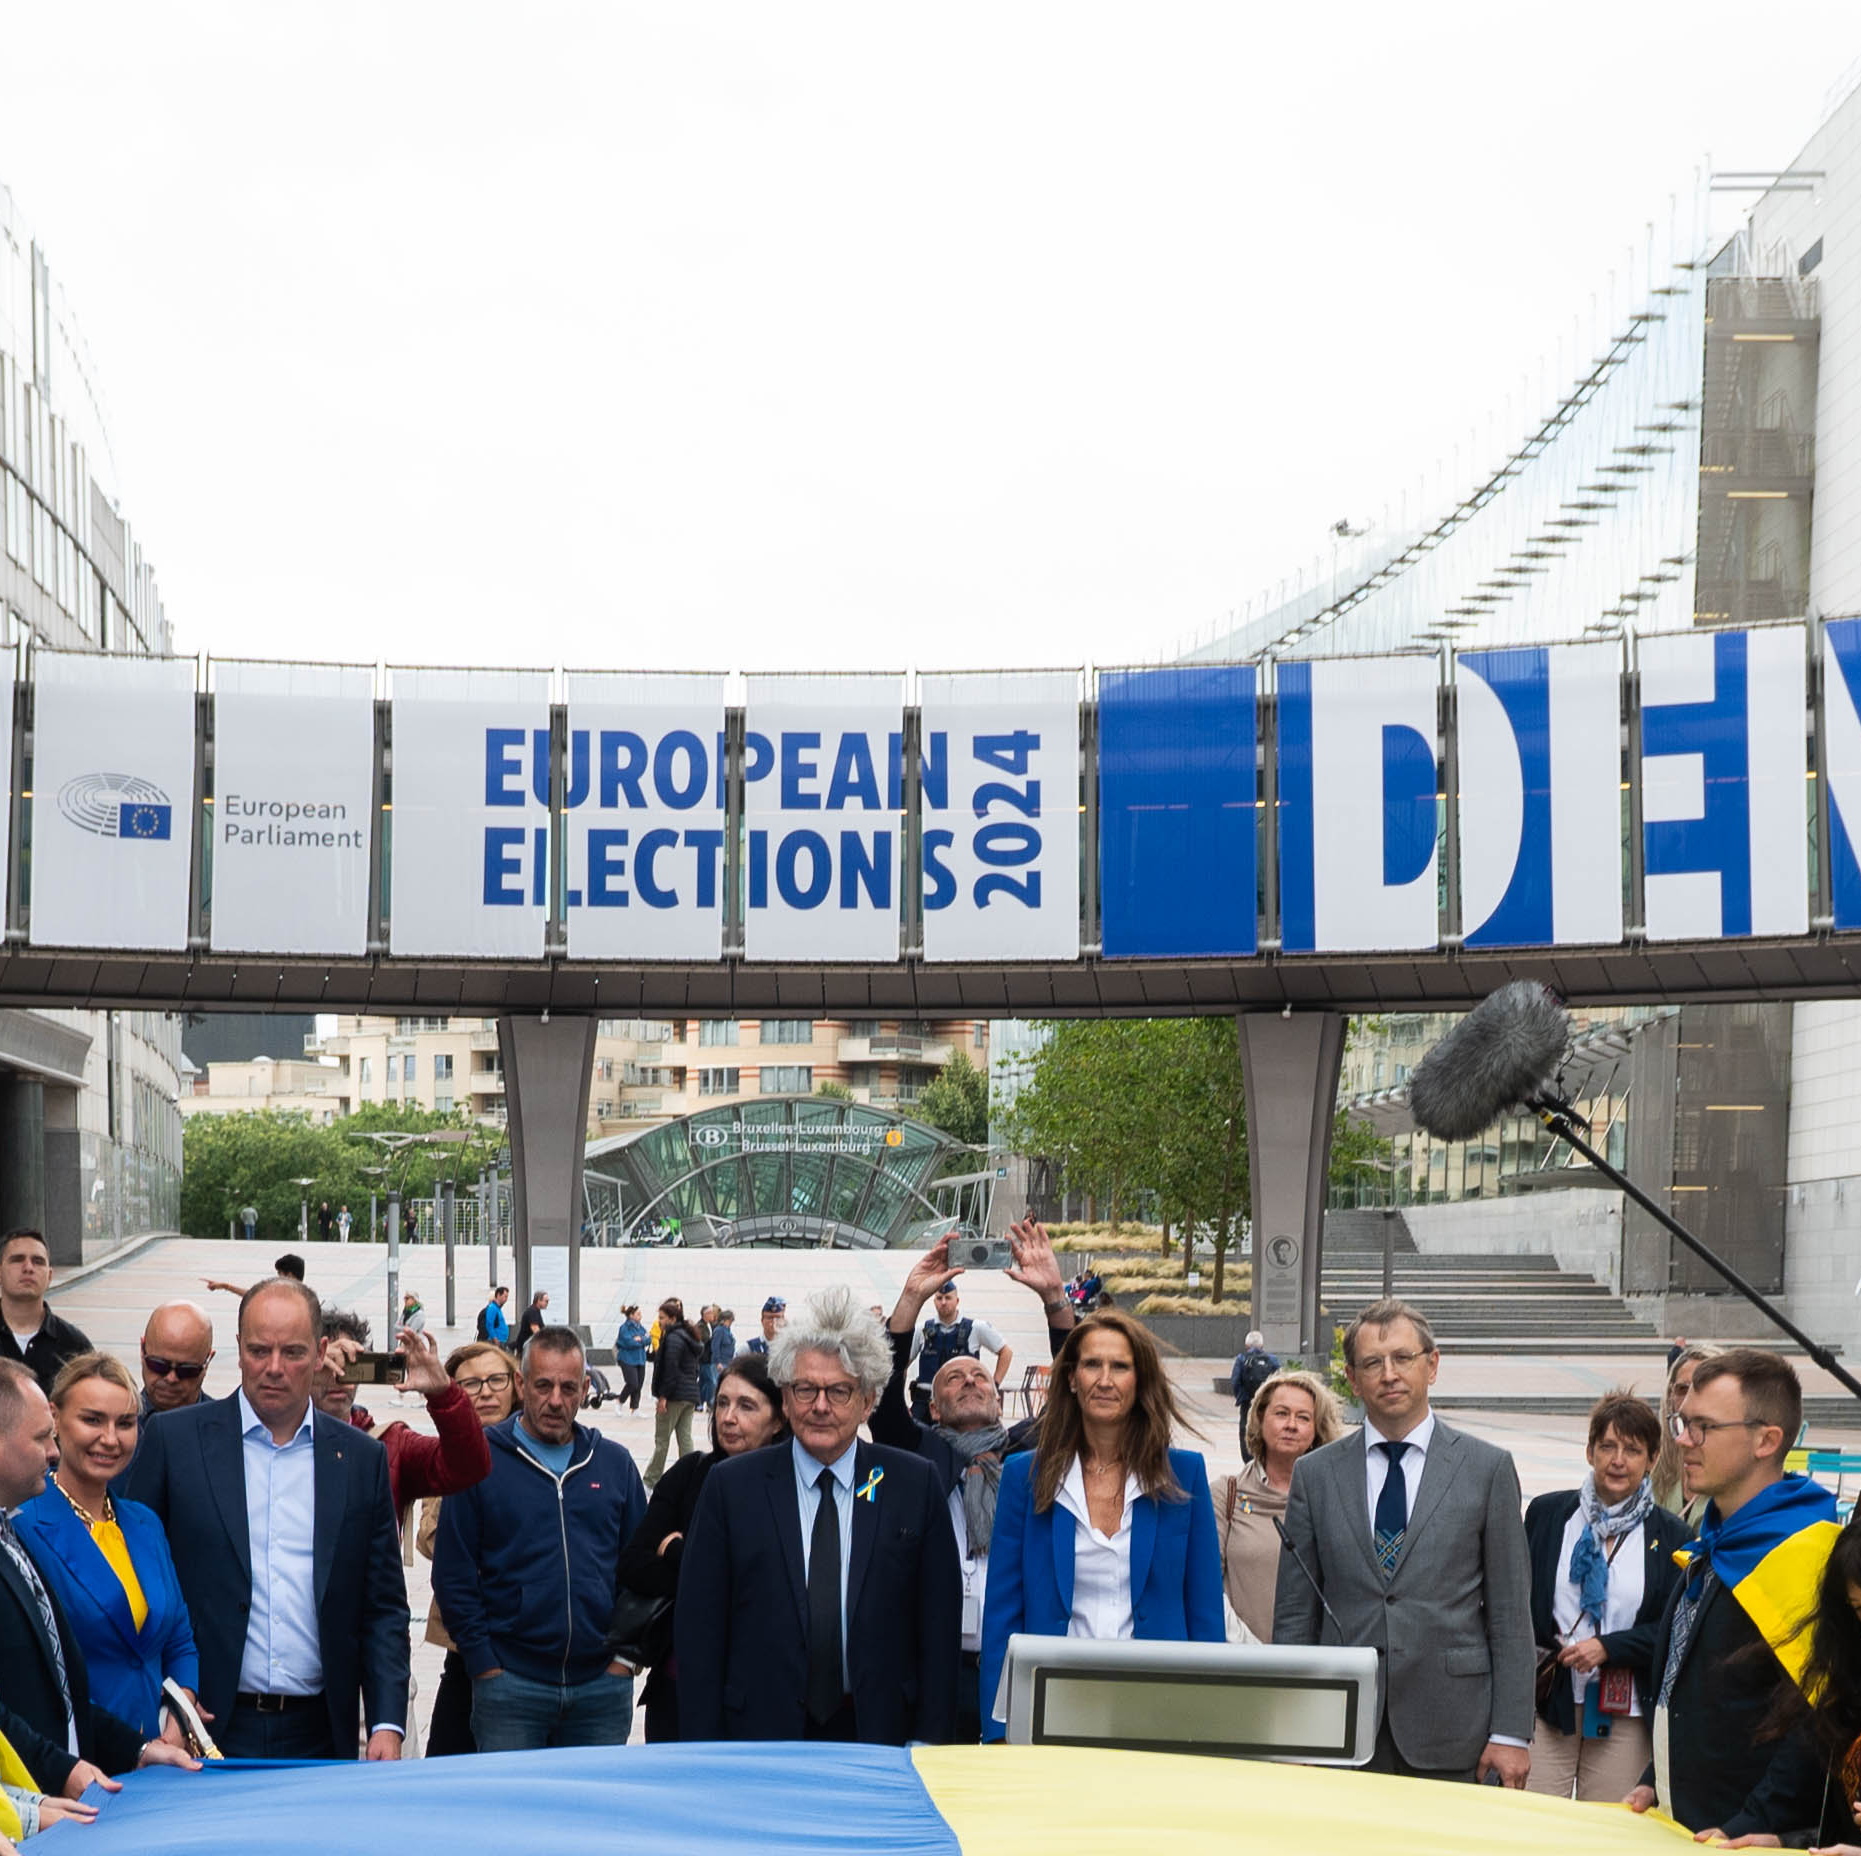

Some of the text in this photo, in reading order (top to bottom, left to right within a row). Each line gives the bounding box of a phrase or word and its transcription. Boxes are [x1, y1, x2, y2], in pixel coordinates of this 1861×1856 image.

[225, 795, 347, 822] European
[484, 728, 948, 811] EUROPEAN
[225, 823, 363, 849] Parliament
[972, 729, 1042, 909] 2024
[482, 826, 958, 911] ELECTIONS
